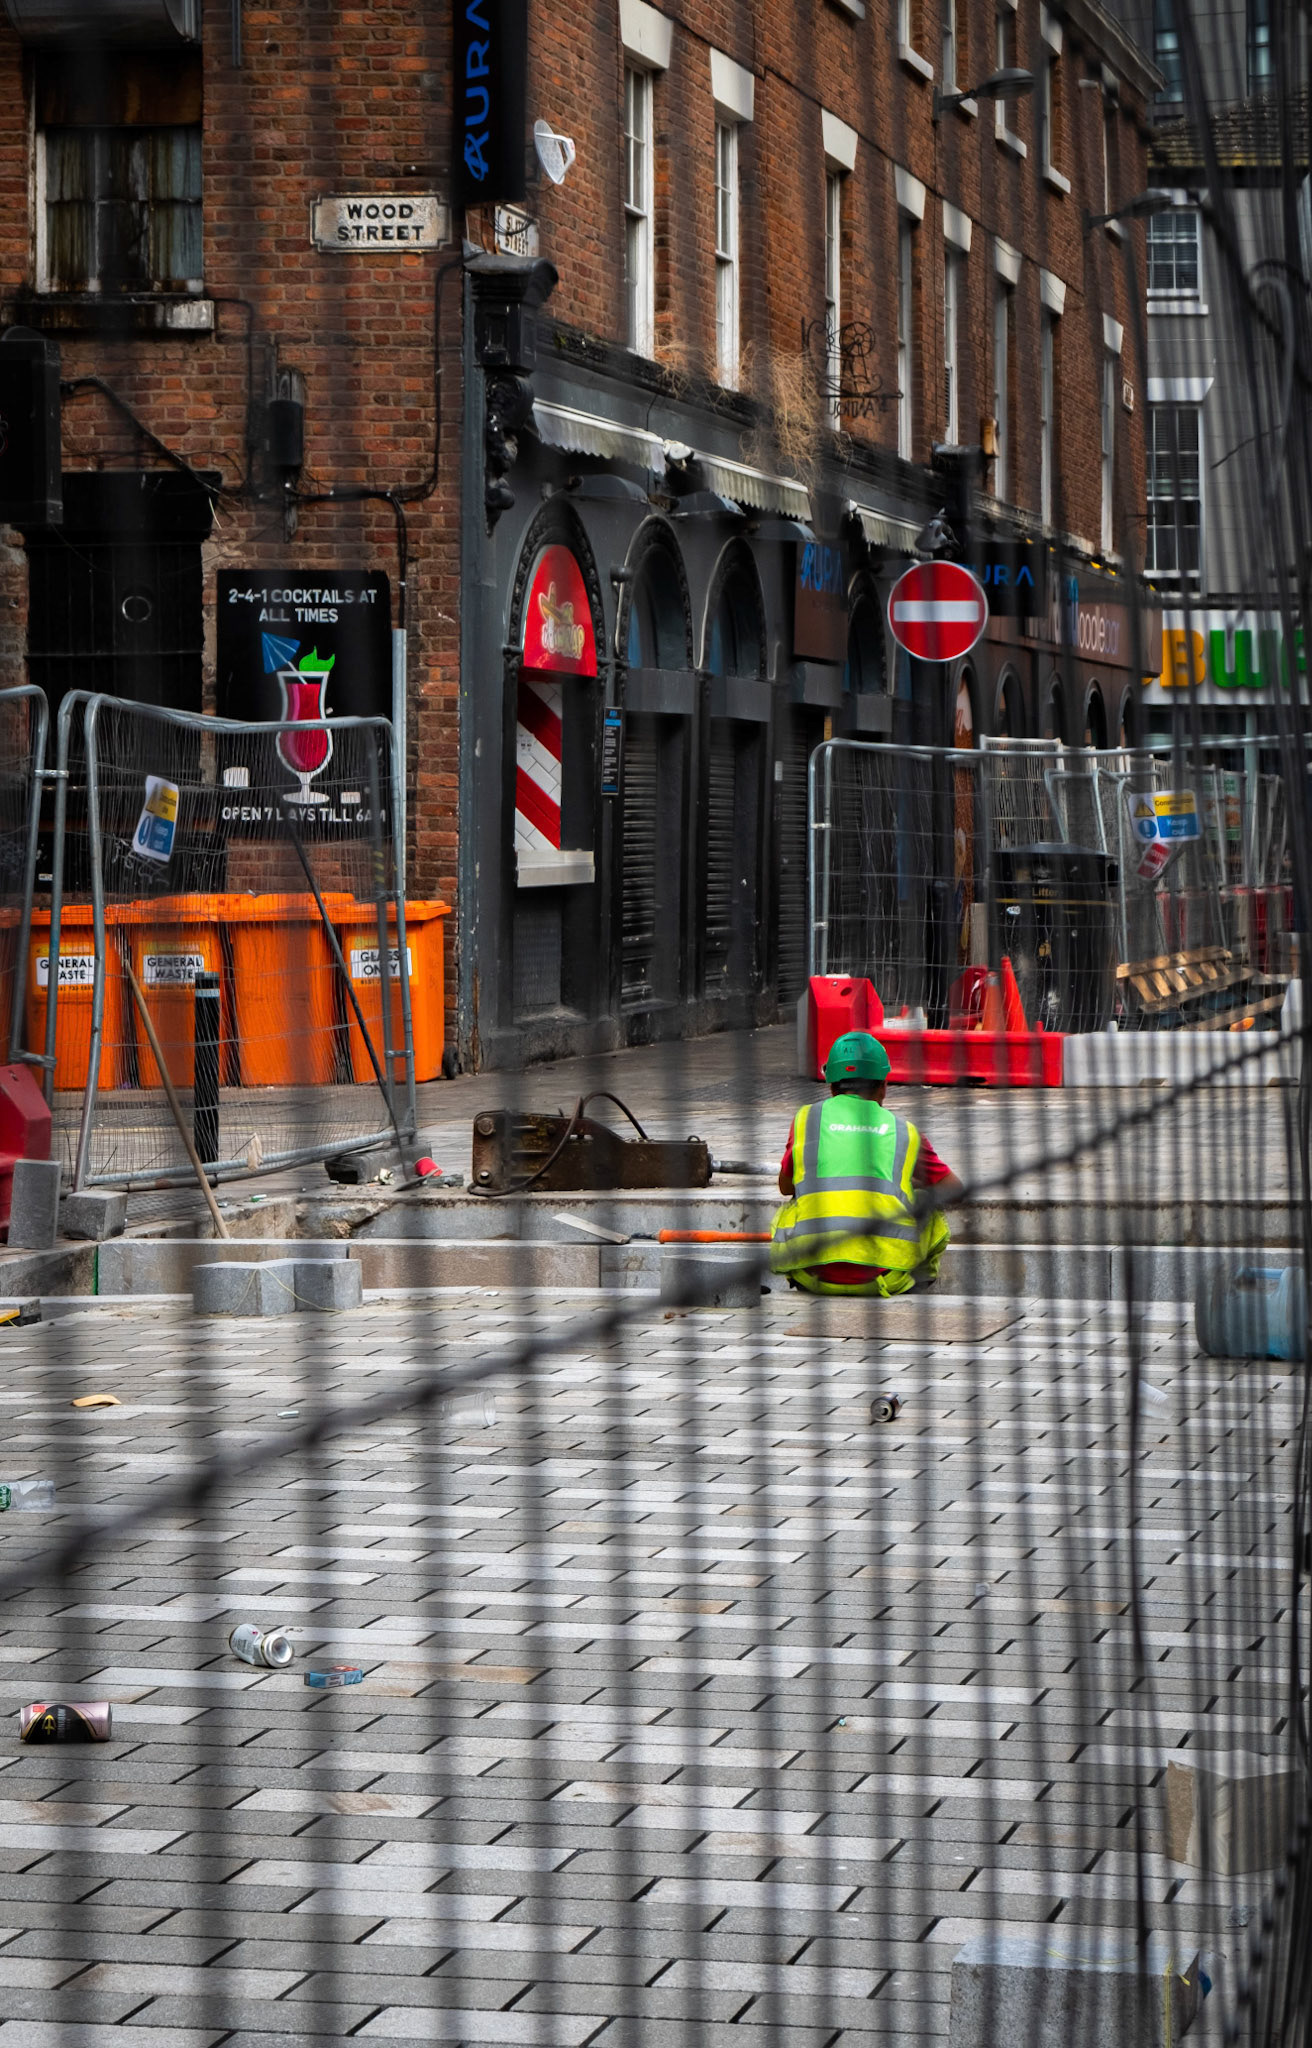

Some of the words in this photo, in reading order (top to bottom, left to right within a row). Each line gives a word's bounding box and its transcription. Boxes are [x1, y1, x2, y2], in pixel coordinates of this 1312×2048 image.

[348, 204, 414, 219] WOOD
[337, 225, 425, 241] STREET
[228, 588, 268, 603] 2-4-1
[270, 589, 355, 603] COCKTAILS
[359, 589, 378, 603] AT
[259, 608, 290, 622] ALL
[295, 608, 339, 622] TIMES
[221, 807, 262, 821] OPEN
[264, 807, 273, 821] 7
[319, 808, 353, 822] TILL
[39, 957, 93, 970] GNERAL
[147, 956, 203, 970] GENERAL
[363, 963, 398, 976] ONY
[58, 969, 86, 982] ASTE
[154, 967, 194, 980] WASTE
[829, 1123, 880, 1134] GRAHAM
